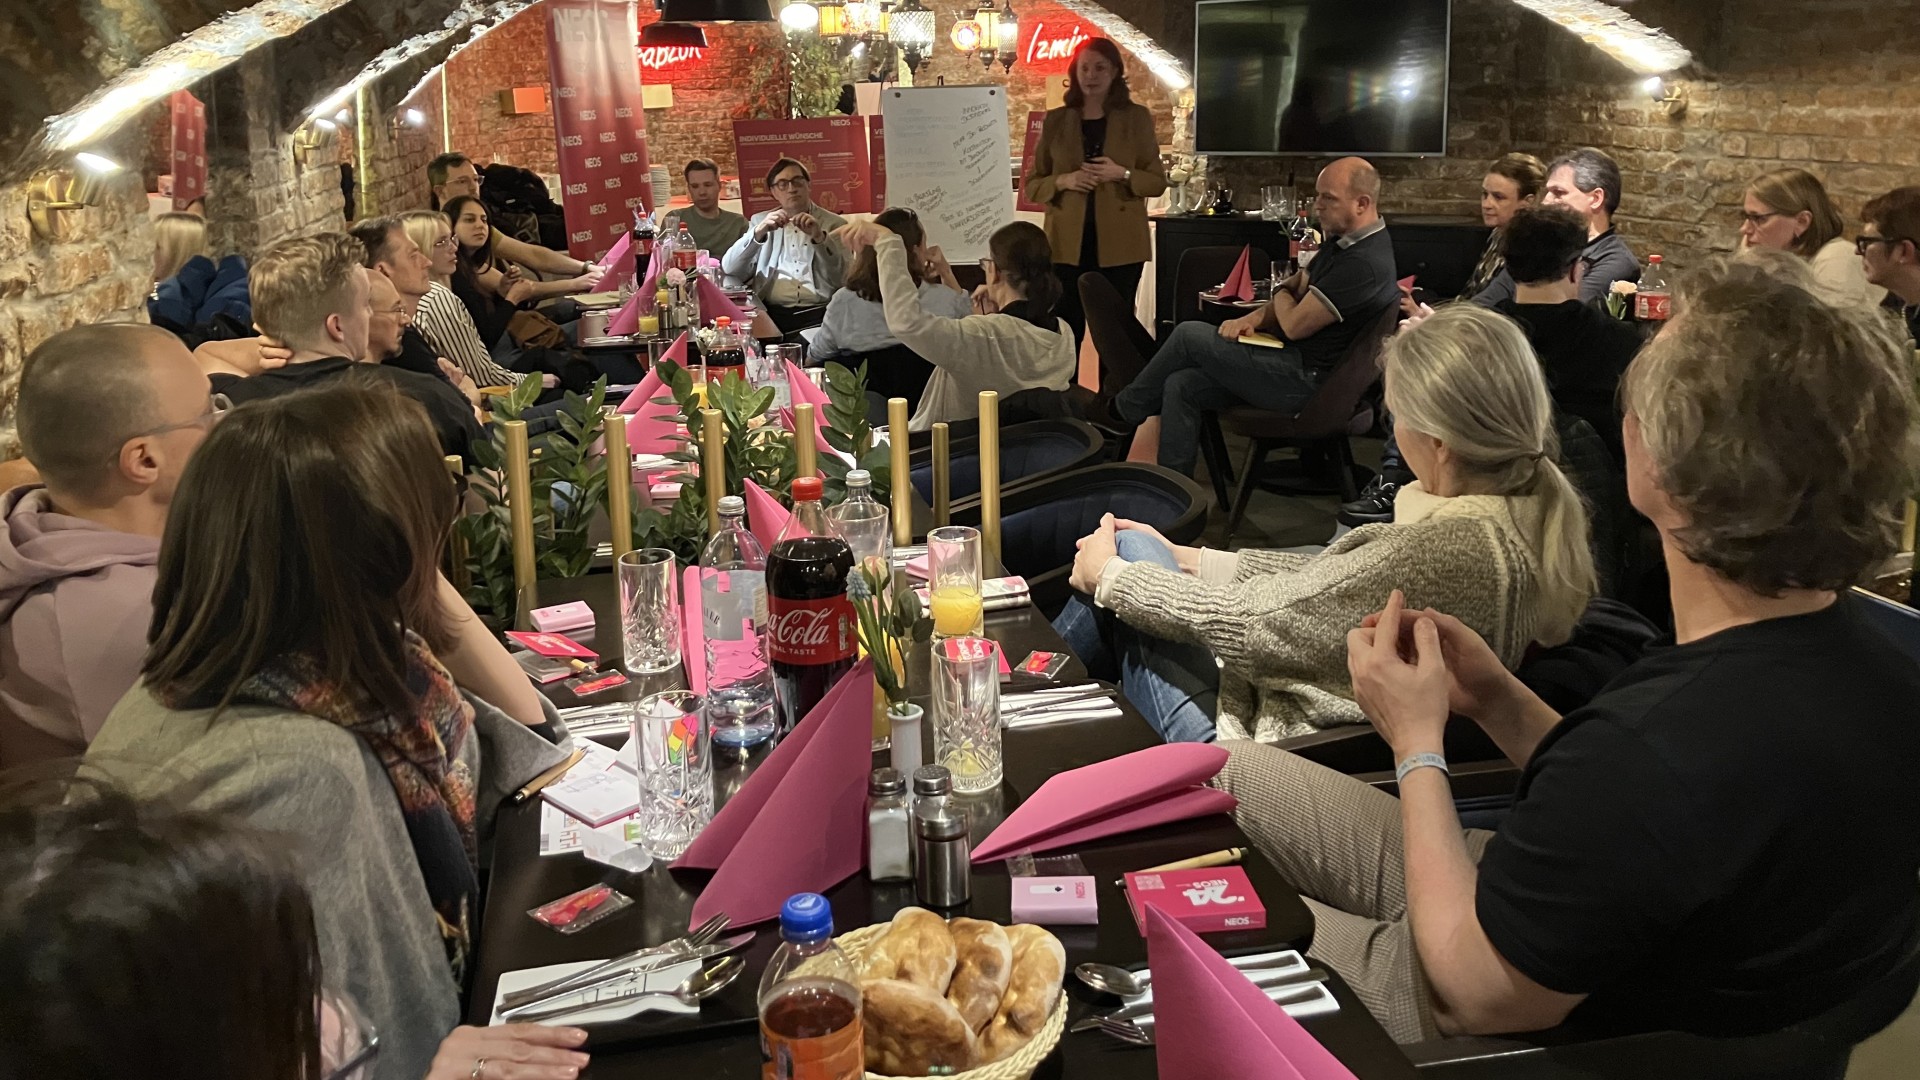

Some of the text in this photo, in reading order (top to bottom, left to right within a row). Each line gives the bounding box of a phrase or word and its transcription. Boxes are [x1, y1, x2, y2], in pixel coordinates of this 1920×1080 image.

[580, 110, 597, 121] NEOS
[615, 108, 633, 118] NEOS
[561, 135, 582, 147] NEOS
[600, 132, 616, 143] NEOS
[739, 132, 824, 142] INDIVIDUELLE WÜNSCHE
[584, 157, 602, 169] NEOS
[620, 153, 638, 164] NEOS
[604, 178, 621, 189] NEOS
[566, 183, 588, 196] NEOS
[590, 203, 607, 215] NEOS
[572, 230, 593, 243] NEOS
[1193, 878, 1228, 888] NEOS
[1075, 881, 1086, 899] NEOS
[1225, 916, 1250, 927] NEOS
